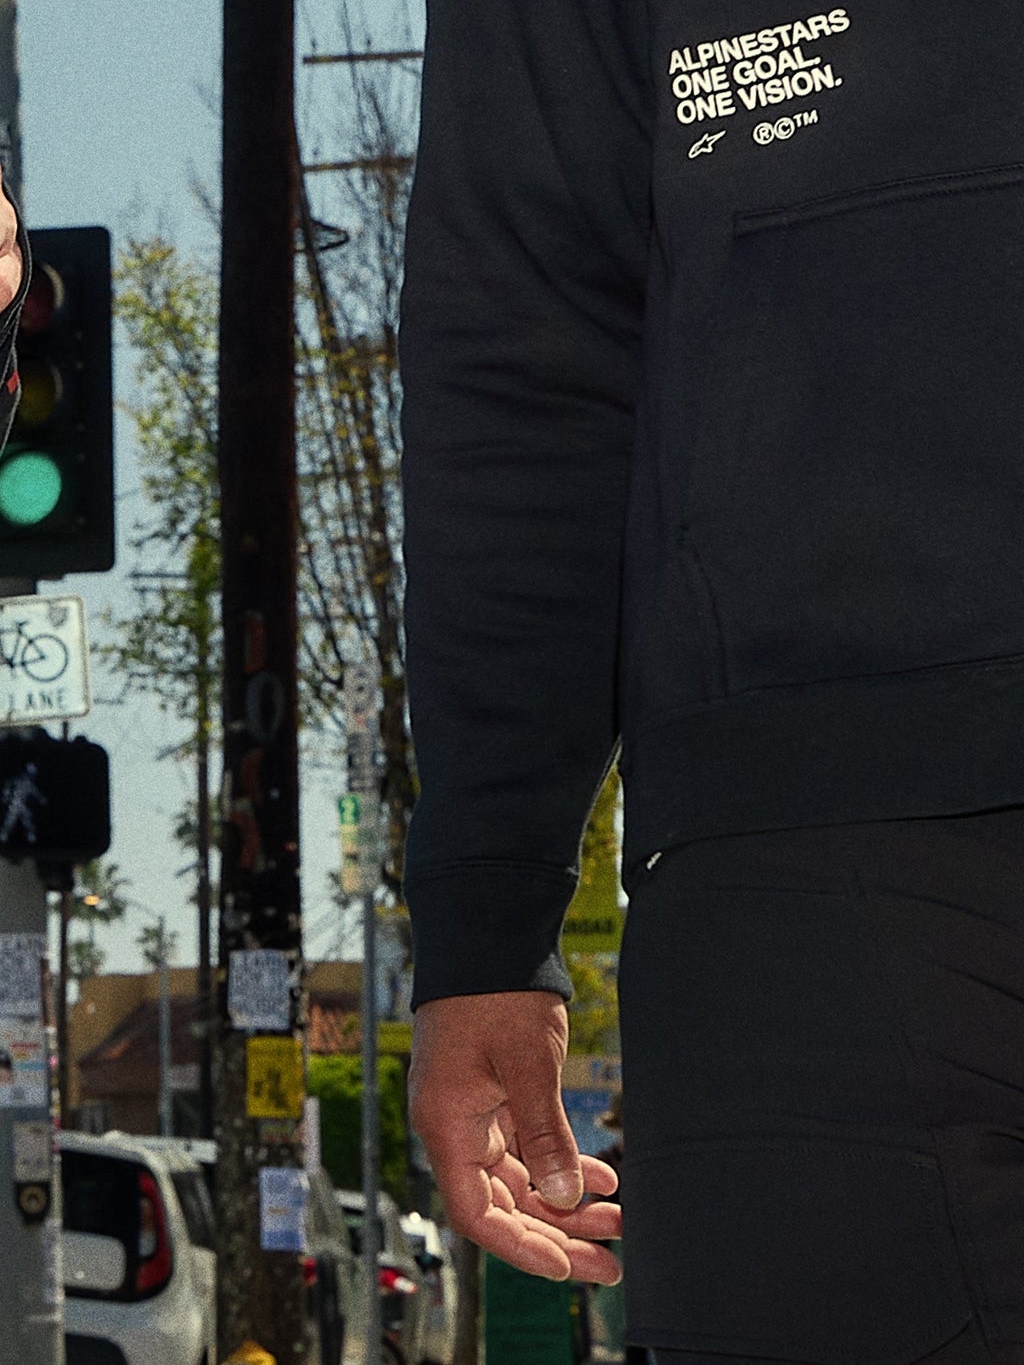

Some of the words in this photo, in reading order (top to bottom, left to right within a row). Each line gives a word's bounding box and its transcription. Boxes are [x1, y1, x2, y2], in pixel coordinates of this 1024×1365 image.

[669, 9, 850, 75] ALPINESTARS
[672, 66, 730, 99] ONE
[733, 46, 821, 85] GOAL.
[676, 91, 736, 124] ONE
[737, 64, 843, 110] VISION.
